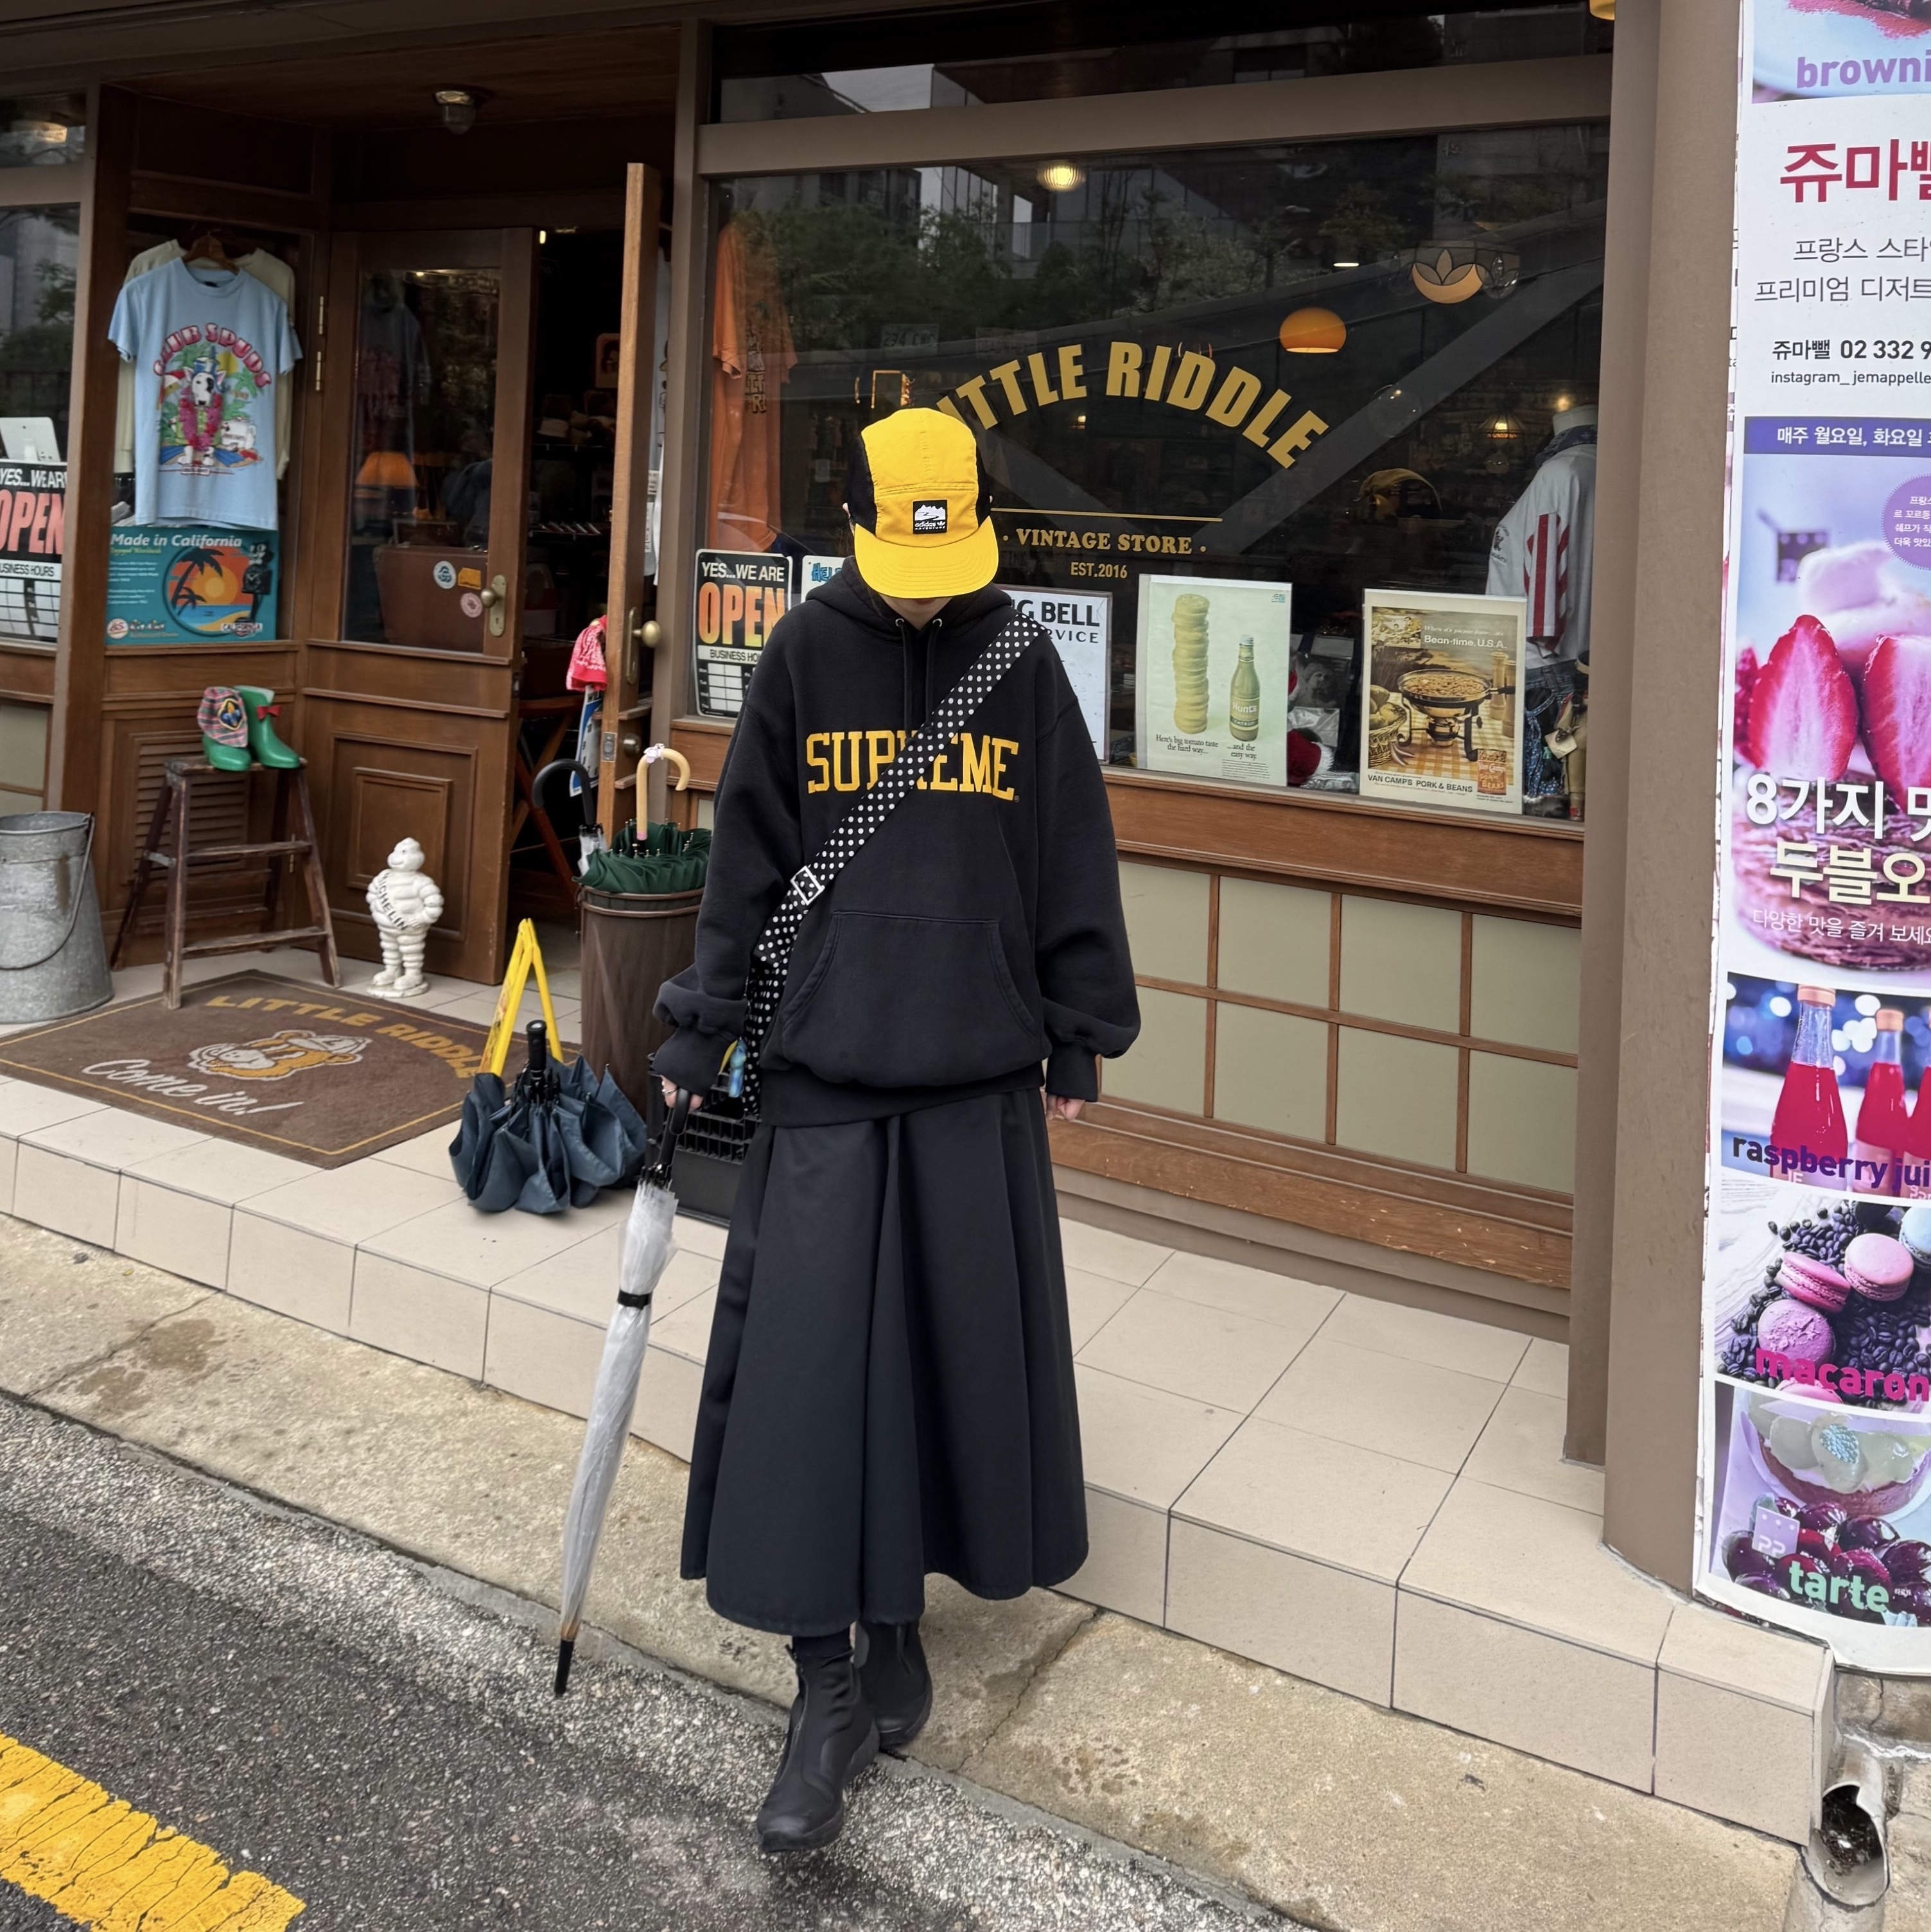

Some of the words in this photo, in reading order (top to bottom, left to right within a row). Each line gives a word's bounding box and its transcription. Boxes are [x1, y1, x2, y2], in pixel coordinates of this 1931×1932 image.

[1794, 237, 1868, 263] 프랑스
[1876, 237, 1931, 263] 스타
[1754, 276, 1848, 302] 프리미엄
[1840, 340, 1867, 359] 02
[1873, 340, 1914, 360] 332
[1105, 341, 1329, 469] RIDDLE
[1778, 426, 1809, 445] 매주
[1814, 426, 1867, 447] 월요일,
[1873, 428, 1922, 447] 화요일
[110, 534, 150, 546] Made
[153, 534, 168, 546] in
[171, 534, 242, 548] California
[1016, 528, 1110, 550] VINTAGE
[1117, 534, 1193, 555] STORE
[758, 566, 785, 582] ARE
[1070, 562, 1128, 579] EST.2016
[699, 582, 785, 647] OPEN
[1042, 601, 1099, 627] BELL
[710, 649, 746, 661] BUSINESS
[1478, 638, 1507, 648] U.S.A.
[1156, 734, 1173, 743] Here's
[1174, 736, 1183, 745] big
[1416, 780, 1437, 788] PORK
[1446, 783, 1473, 792] BEANS
[1746, 773, 1884, 840] 8가지
[1753, 909, 1803, 932] 다양한
[1809, 916, 1844, 938] 맛을
[1849, 919, 1883, 942] 즐겨
[205, 995, 385, 1027] LITTLE
[82, 1059, 208, 1097] Come
[193, 1091, 304, 1115] in!
[1733, 1136, 1889, 1189] raspberry
[1756, 1348, 1929, 1402] macaron
[1789, 1560, 1890, 1614] tarte
